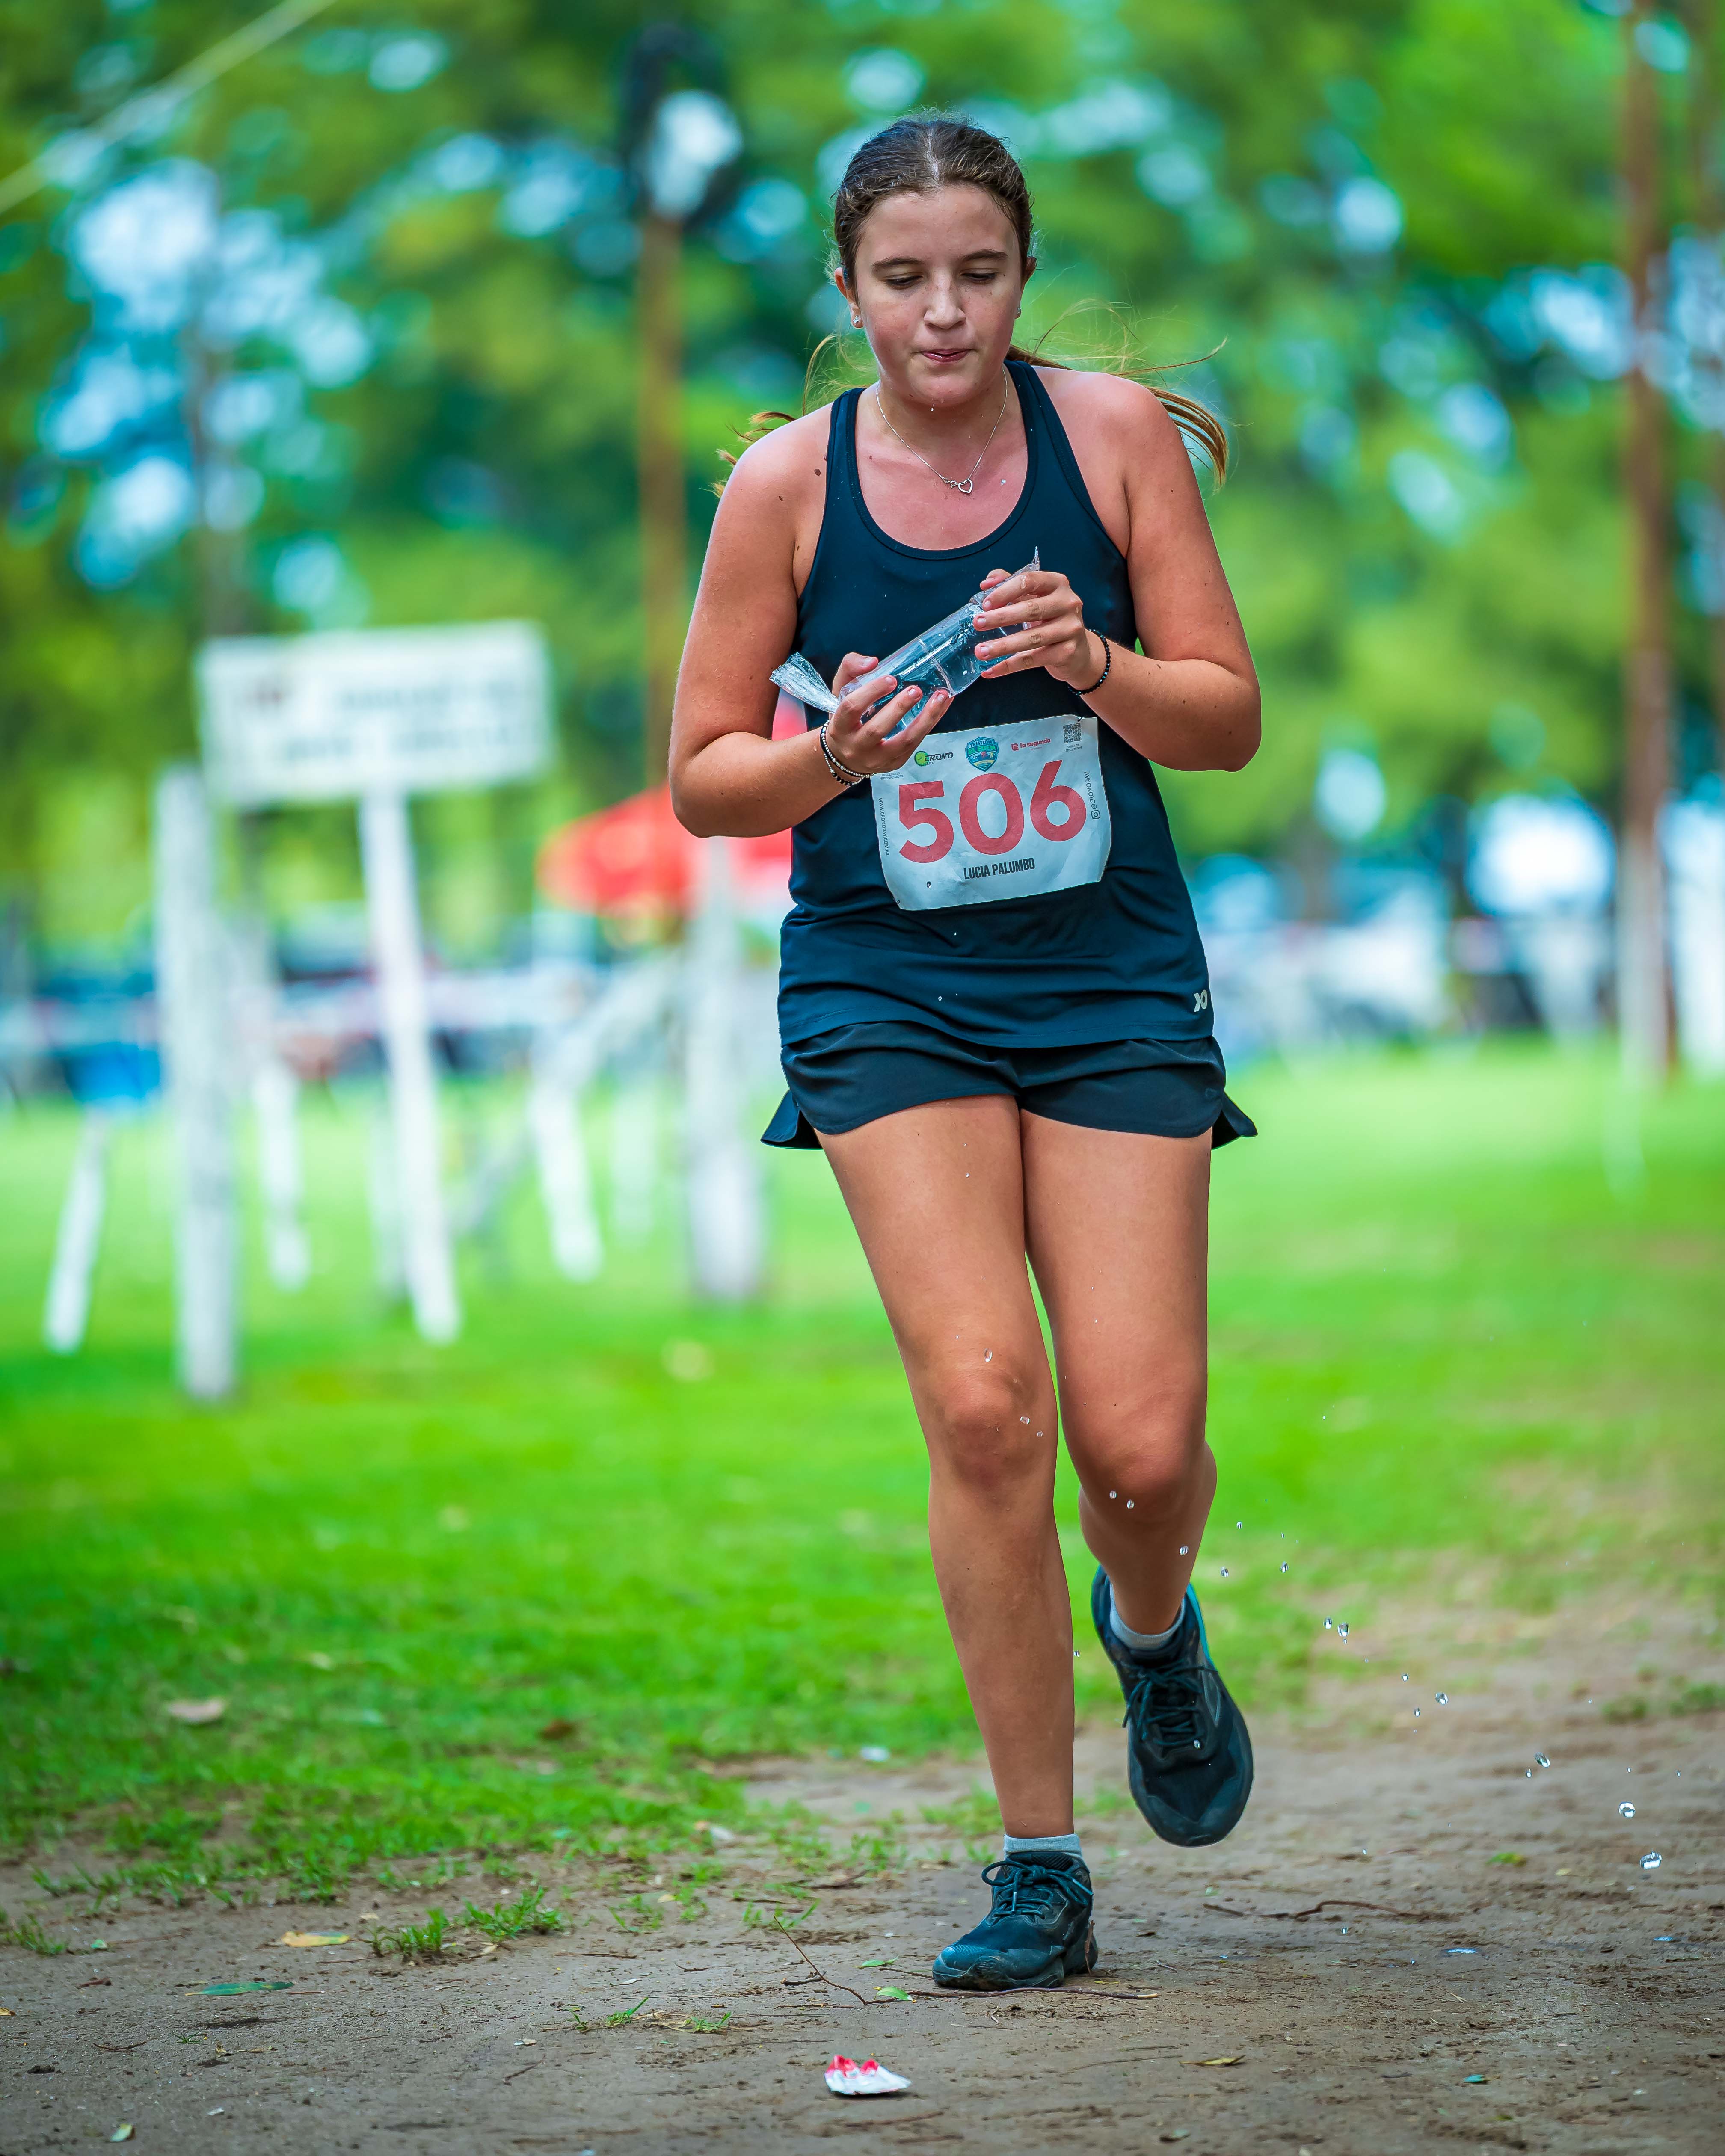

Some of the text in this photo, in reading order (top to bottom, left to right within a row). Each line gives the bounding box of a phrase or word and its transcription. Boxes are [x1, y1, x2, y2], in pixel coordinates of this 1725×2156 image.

[925, 752, 954, 761] CRONO
[1027, 738, 1051, 746] segunda
[1084, 772, 1097, 808] @CRONORAV
[899, 760, 1086, 863] 506
[879, 797, 889, 856] WWW.CRONORAV.COM.AR
[963, 857, 1035, 880] LUCIA PALUMBO
